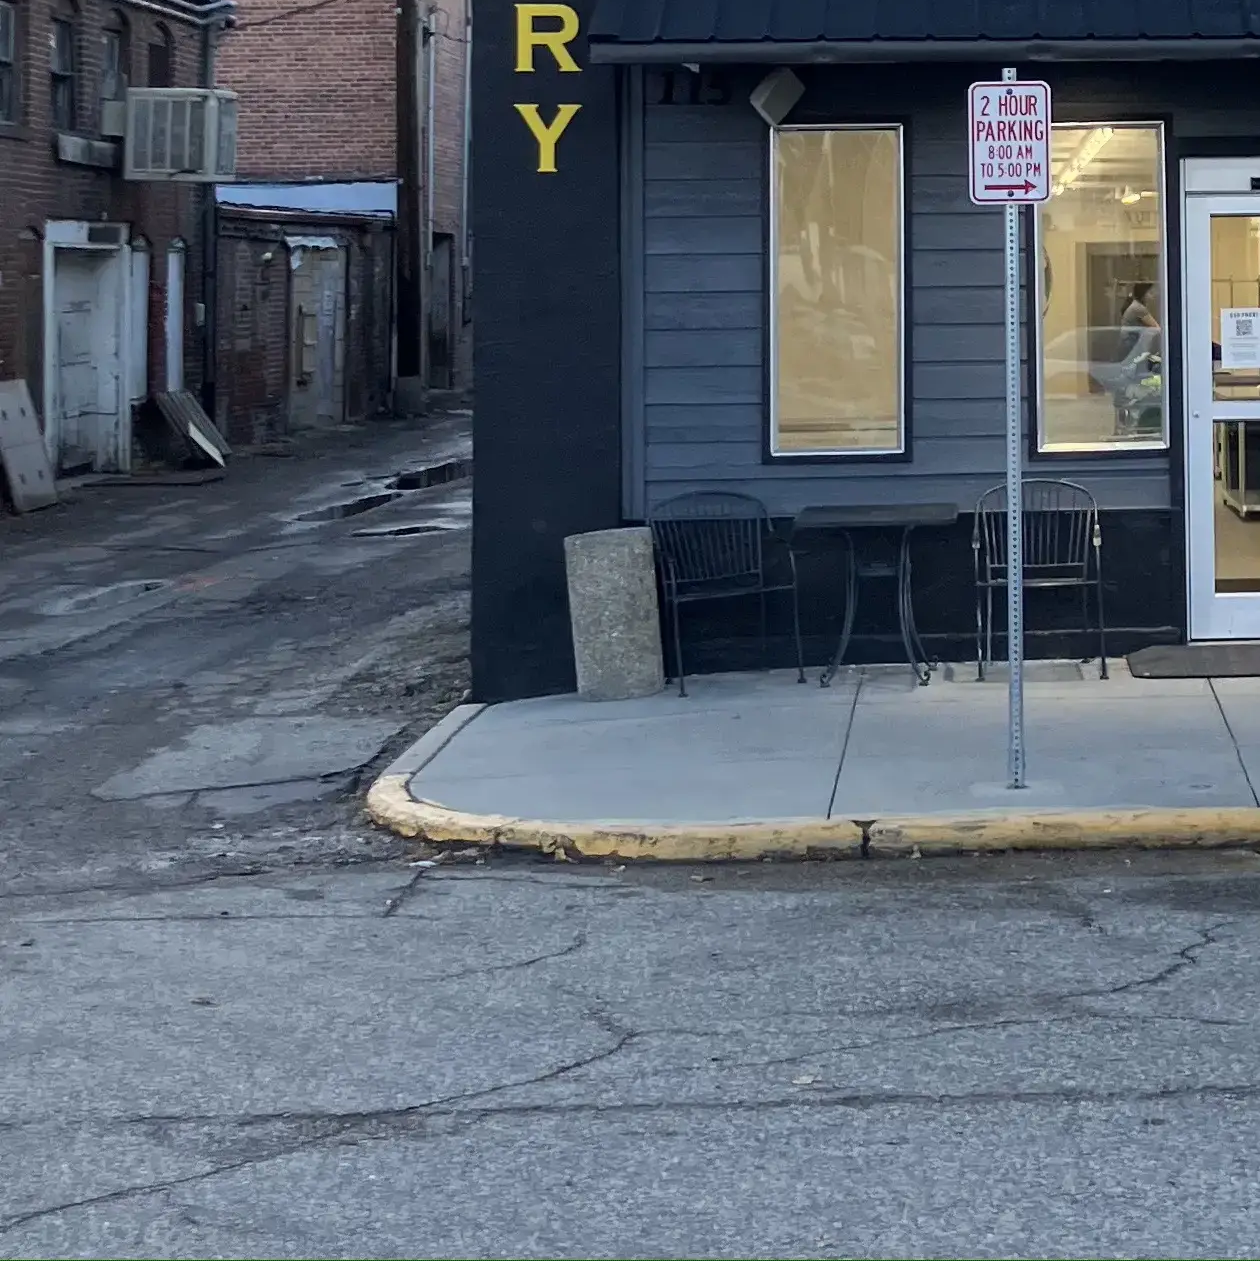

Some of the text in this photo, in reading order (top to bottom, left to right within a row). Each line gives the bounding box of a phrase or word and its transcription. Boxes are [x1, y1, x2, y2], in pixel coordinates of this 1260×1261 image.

[980, 95, 1037, 116] 2 HOUR
[976, 120, 1044, 141] PARKING
[988, 145, 1033, 160] 8:00 AM
[980, 163, 1041, 178] TO 5:00 PM
